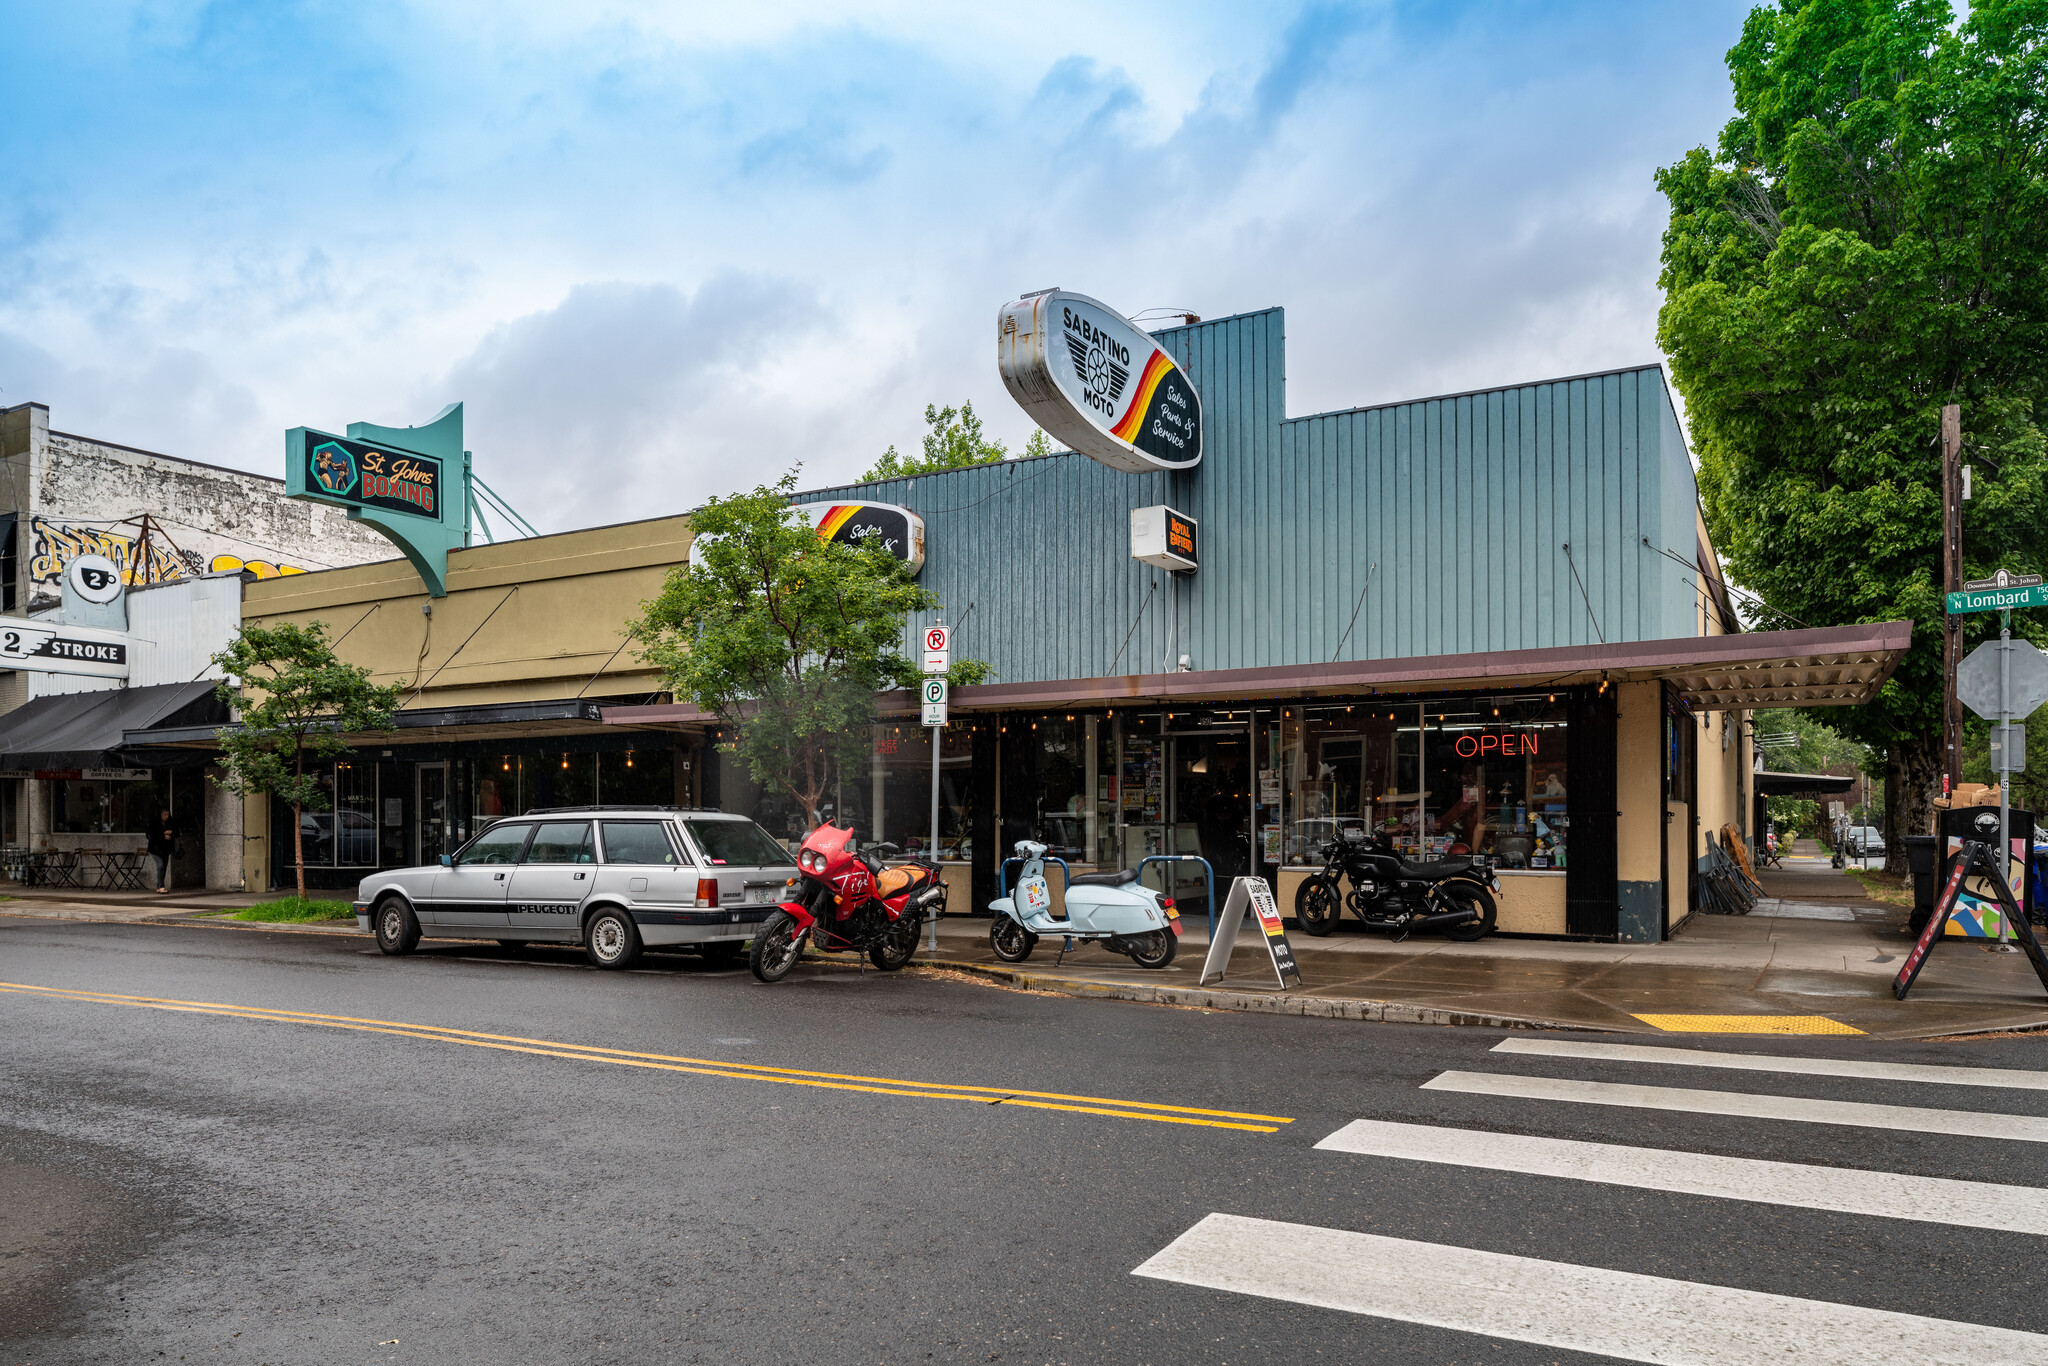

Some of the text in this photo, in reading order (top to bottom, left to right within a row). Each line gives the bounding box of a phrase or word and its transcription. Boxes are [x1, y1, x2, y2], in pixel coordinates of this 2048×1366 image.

[1063, 307, 1130, 366] SABATINO
[1083, 387, 1114, 418] MOTO
[1167, 385, 1187, 409] Sales
[1152, 419, 1185, 449] Service
[1161, 403, 1196, 440] Parts &
[362, 452, 434, 485] St. Johns
[361, 471, 434, 512] BOXING
[1171, 517, 1191, 538] ROYAL
[1169, 531, 1193, 553] ENFIELD
[89, 572, 101, 587] 2
[1967, 582, 1997, 590] Downtown
[2019, 578, 2039, 586] Johns
[1954, 600, 1962, 609] N
[1967, 590, 2029, 608] Lombard
[4, 631, 118, 660] 2 STROKE
[1456, 733, 1538, 758] OPEN
[518, 904, 573, 915] PEUGEOT
